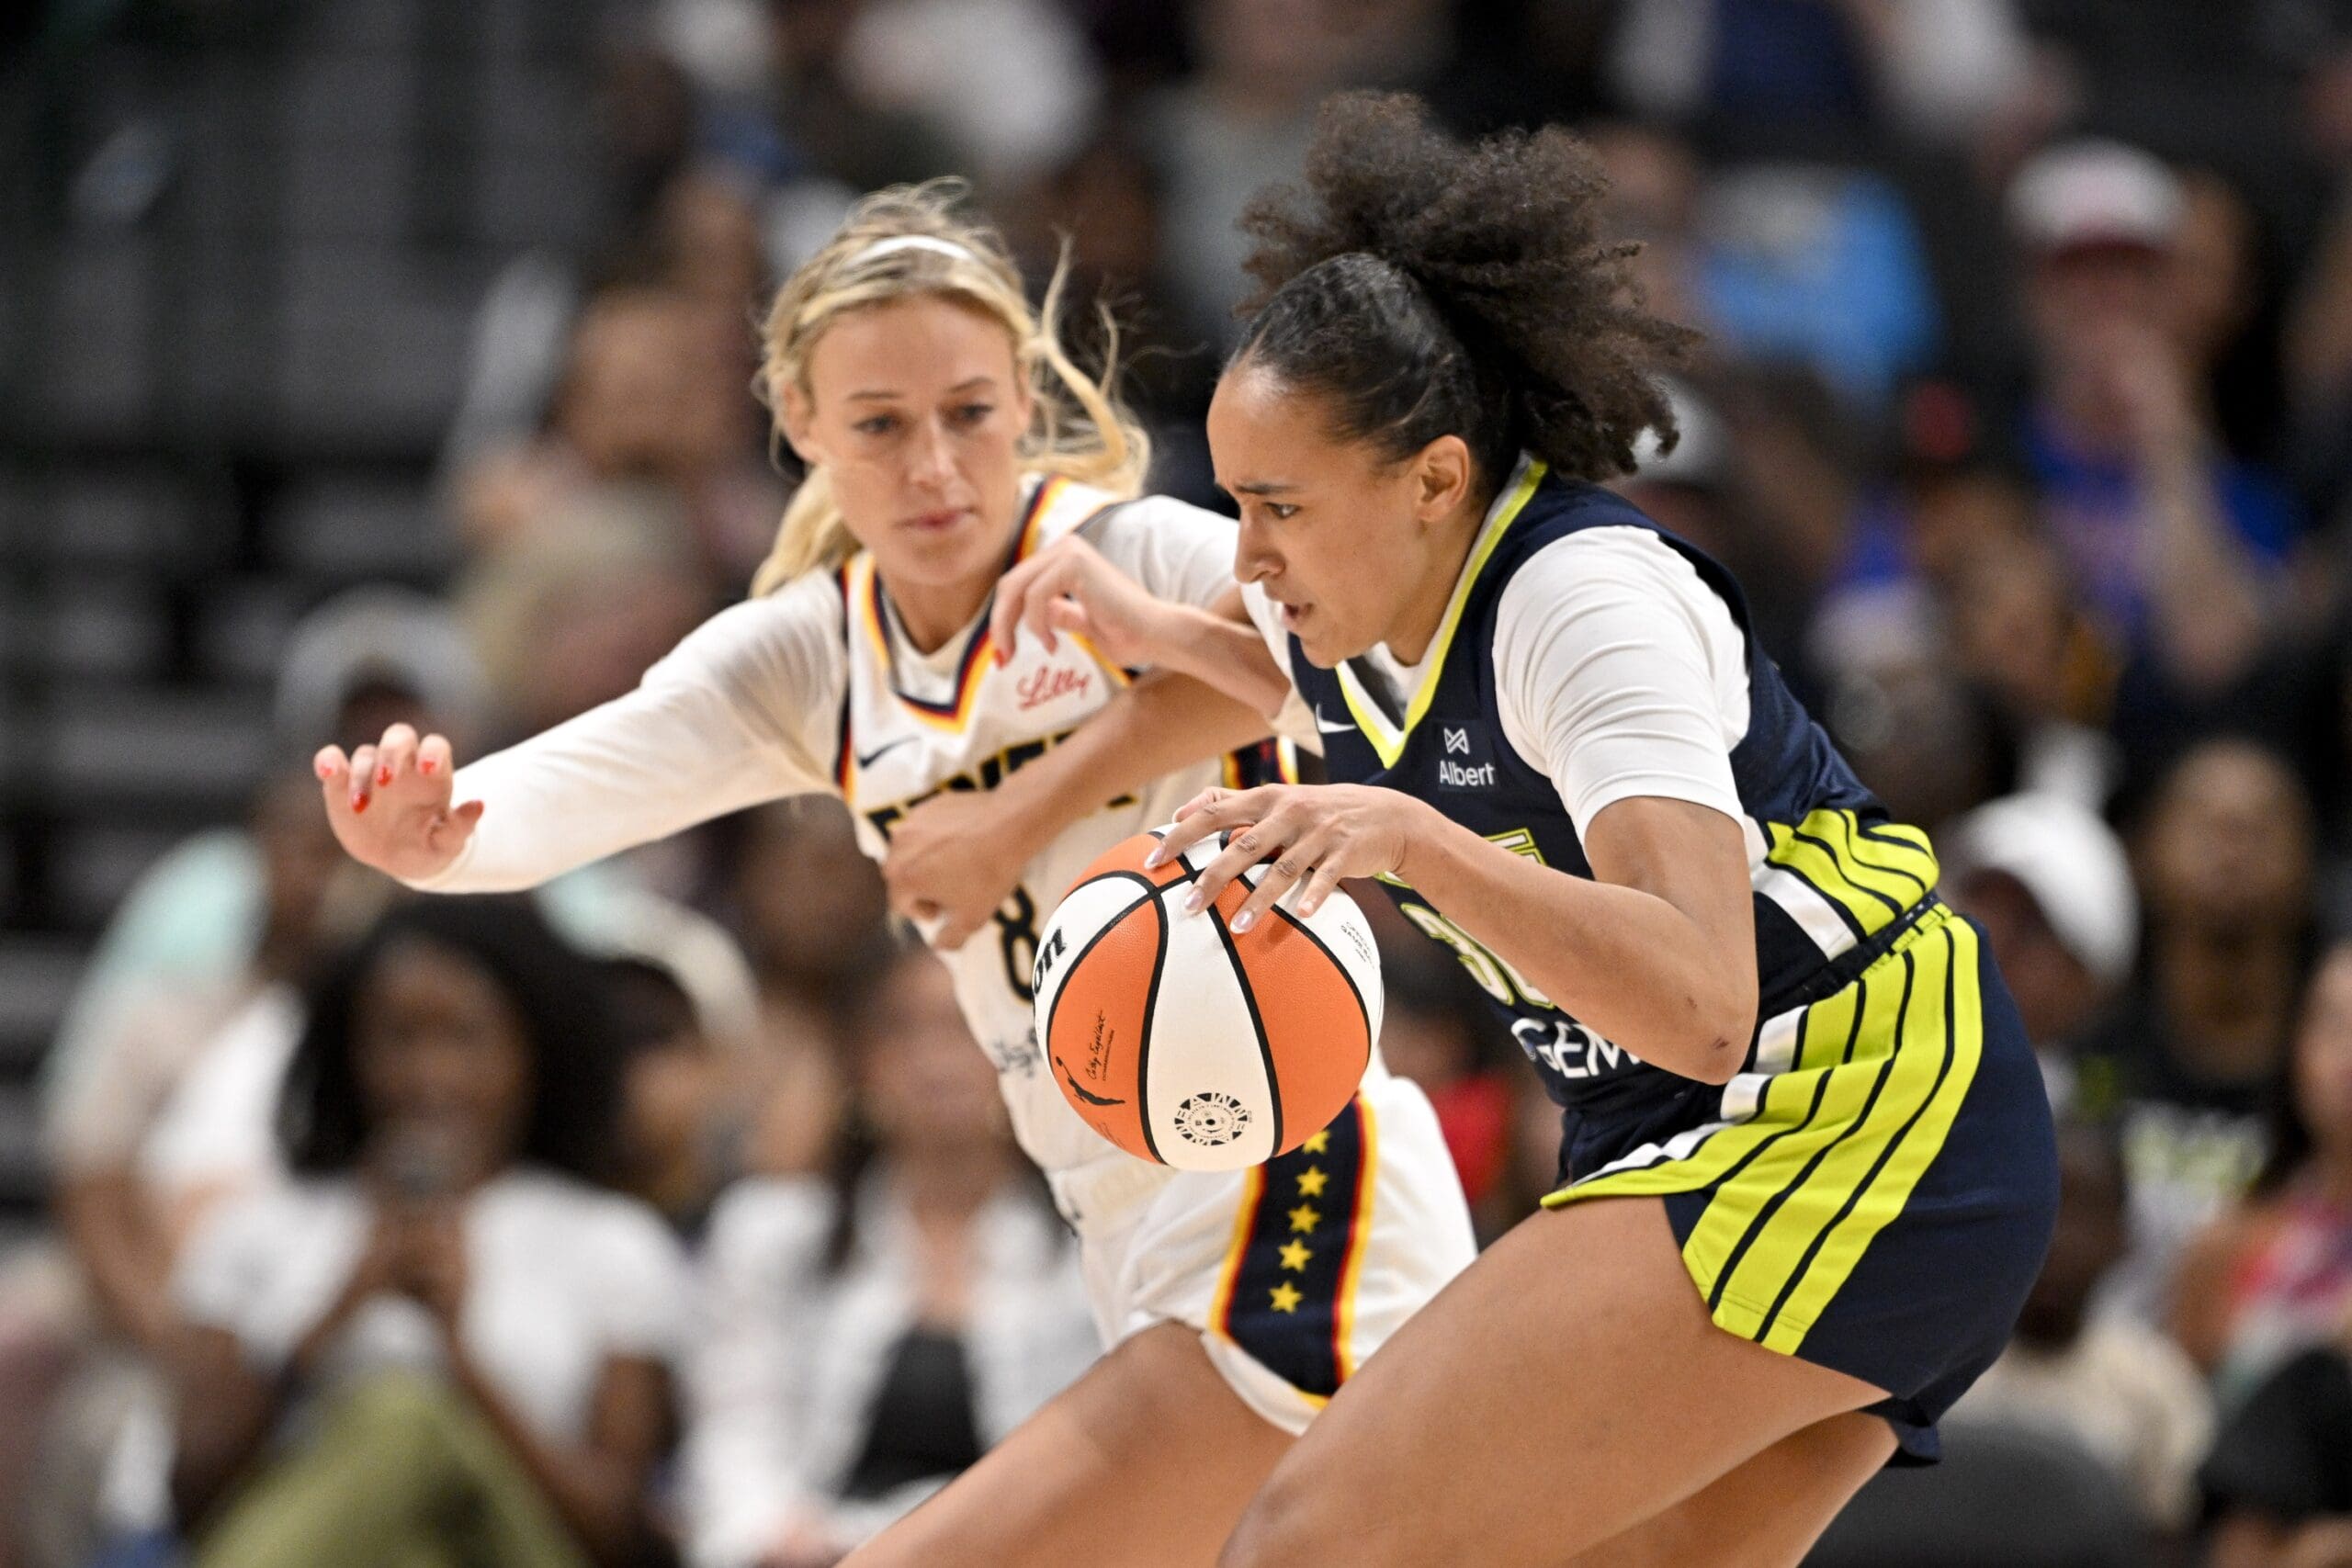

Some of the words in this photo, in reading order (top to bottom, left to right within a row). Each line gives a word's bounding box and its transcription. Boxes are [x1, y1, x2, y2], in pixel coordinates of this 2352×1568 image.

[1016, 665, 1092, 711] Lilly
[1440, 760, 1495, 786] Albert
[992, 883, 1044, 1004] 8
